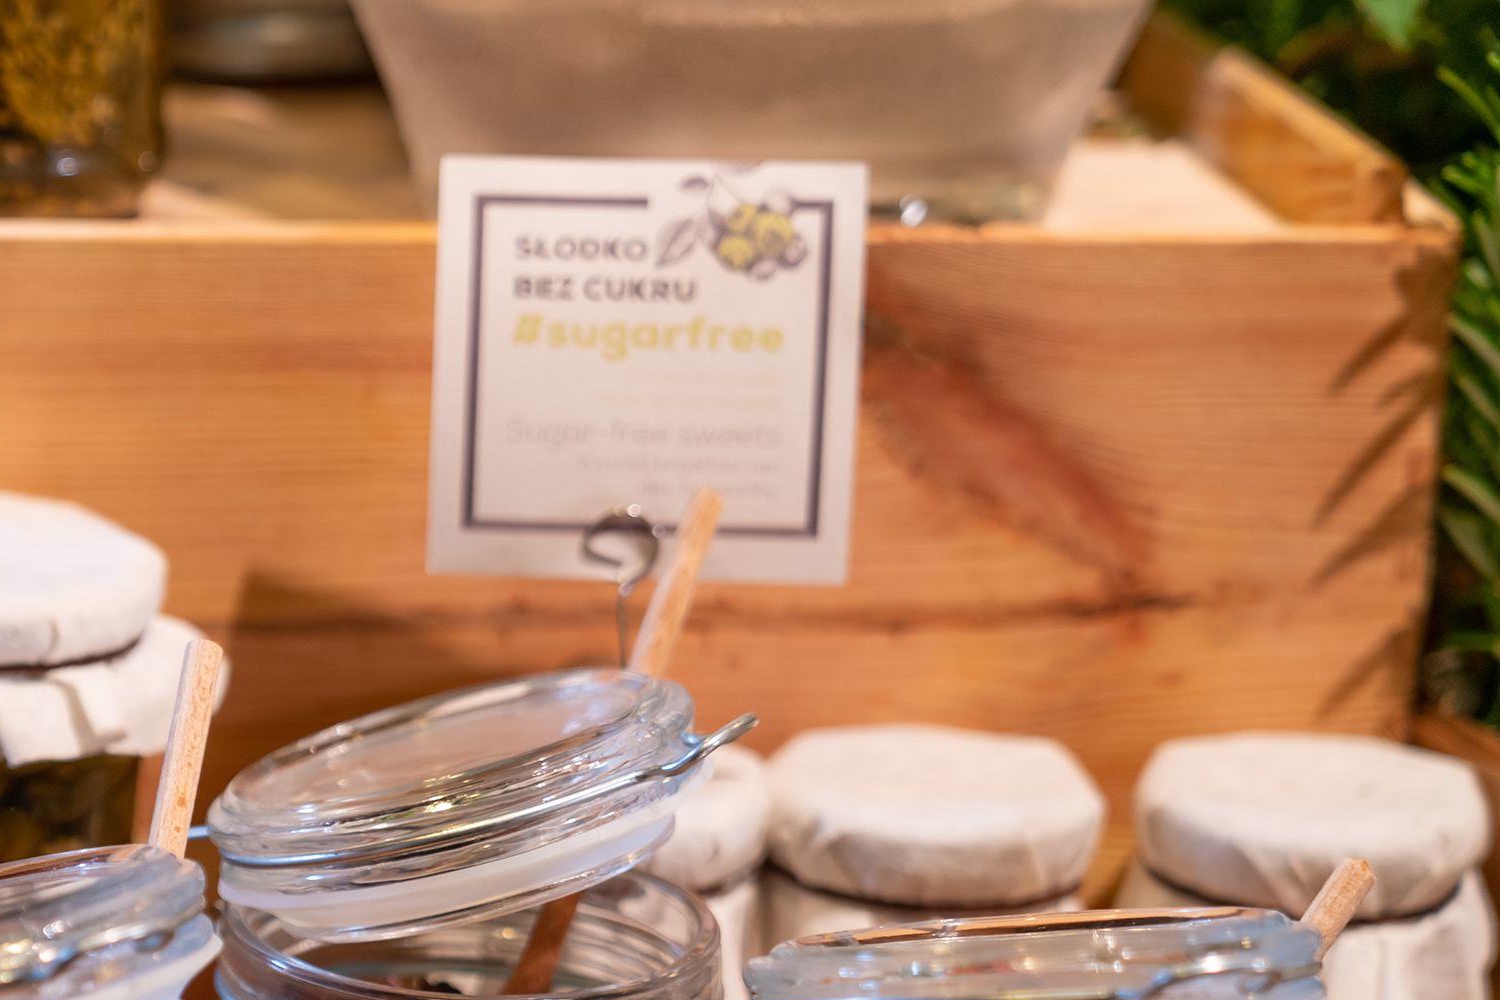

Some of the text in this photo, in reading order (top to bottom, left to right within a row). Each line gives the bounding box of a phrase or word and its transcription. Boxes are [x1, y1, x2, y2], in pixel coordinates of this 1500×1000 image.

[513, 235, 649, 262] SŁODKO
[513, 276, 697, 302] BEZ CUKRU
[512, 312, 786, 362] #sugarfree
